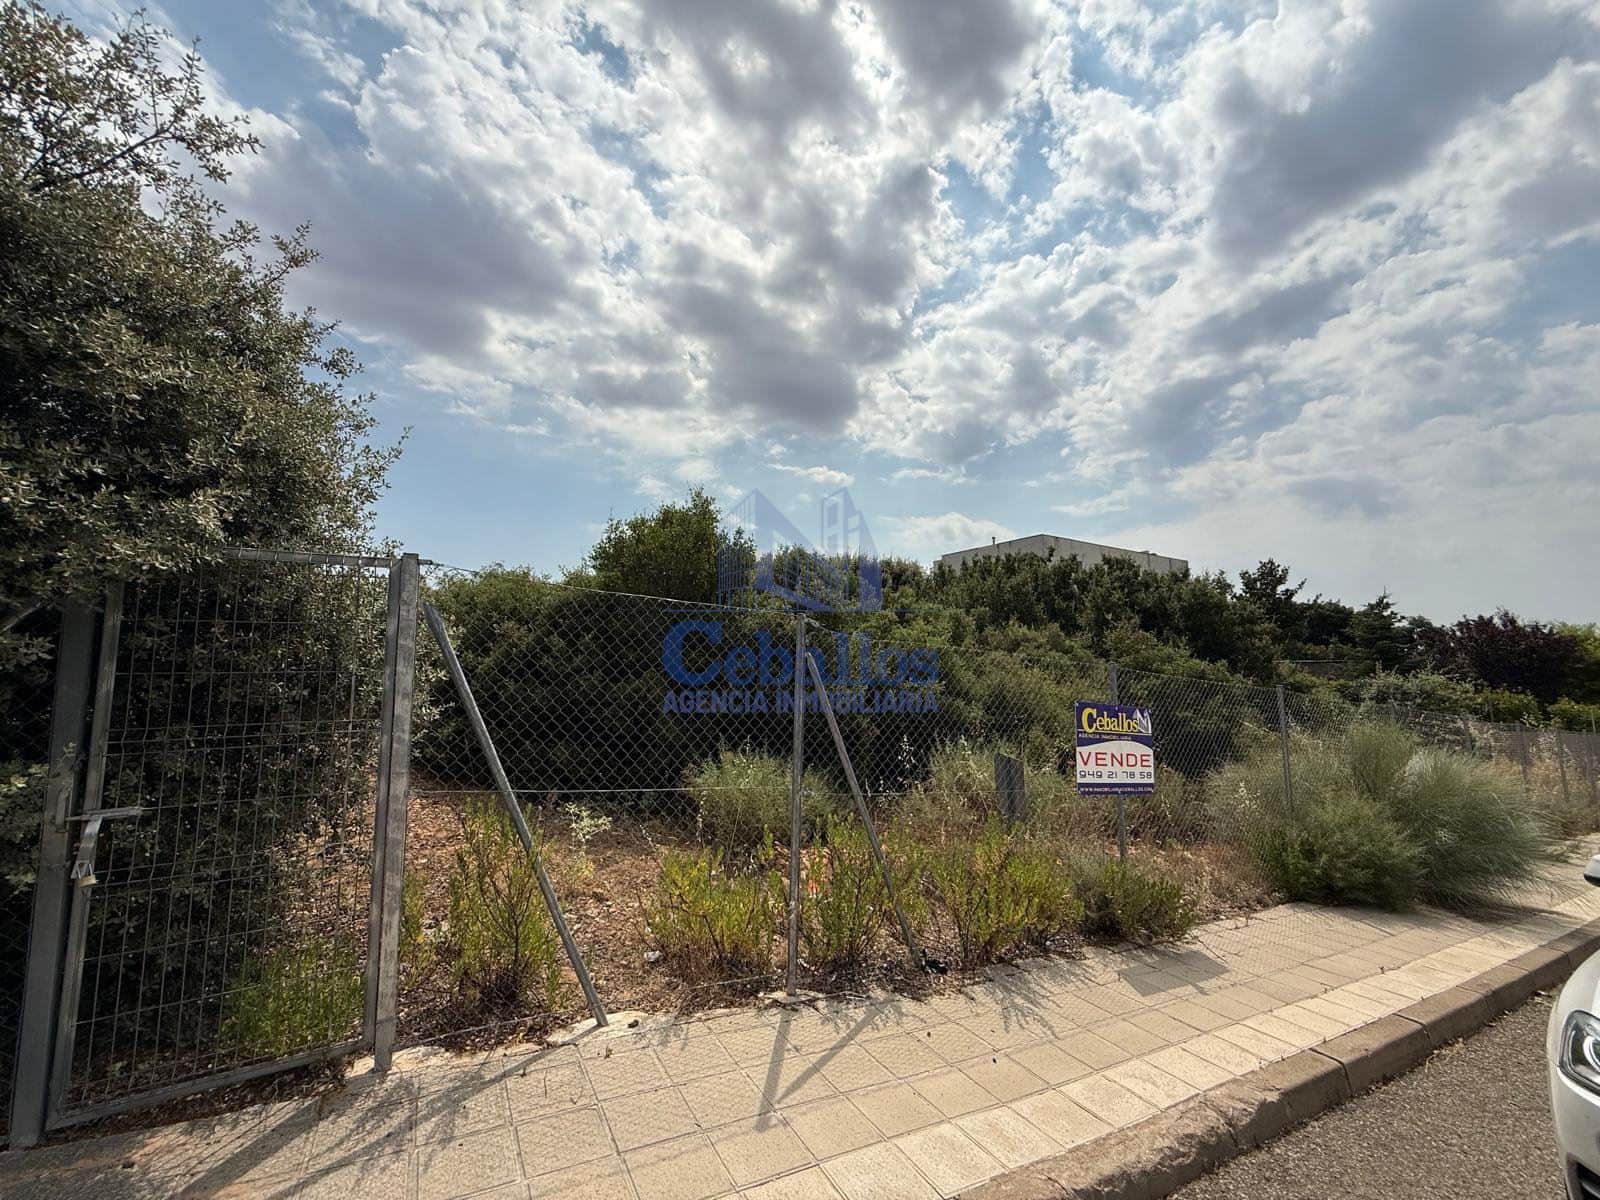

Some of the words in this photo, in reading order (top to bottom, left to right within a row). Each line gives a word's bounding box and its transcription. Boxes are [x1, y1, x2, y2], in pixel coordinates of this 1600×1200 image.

[1081, 707, 1139, 733] Ceballos
[1079, 751, 1152, 768] VENDE
[1079, 770, 1103, 779] 949
[1107, 771, 1117, 779] 21
[1121, 771, 1136, 780] 78
[1139, 771, 1152, 780] 58
